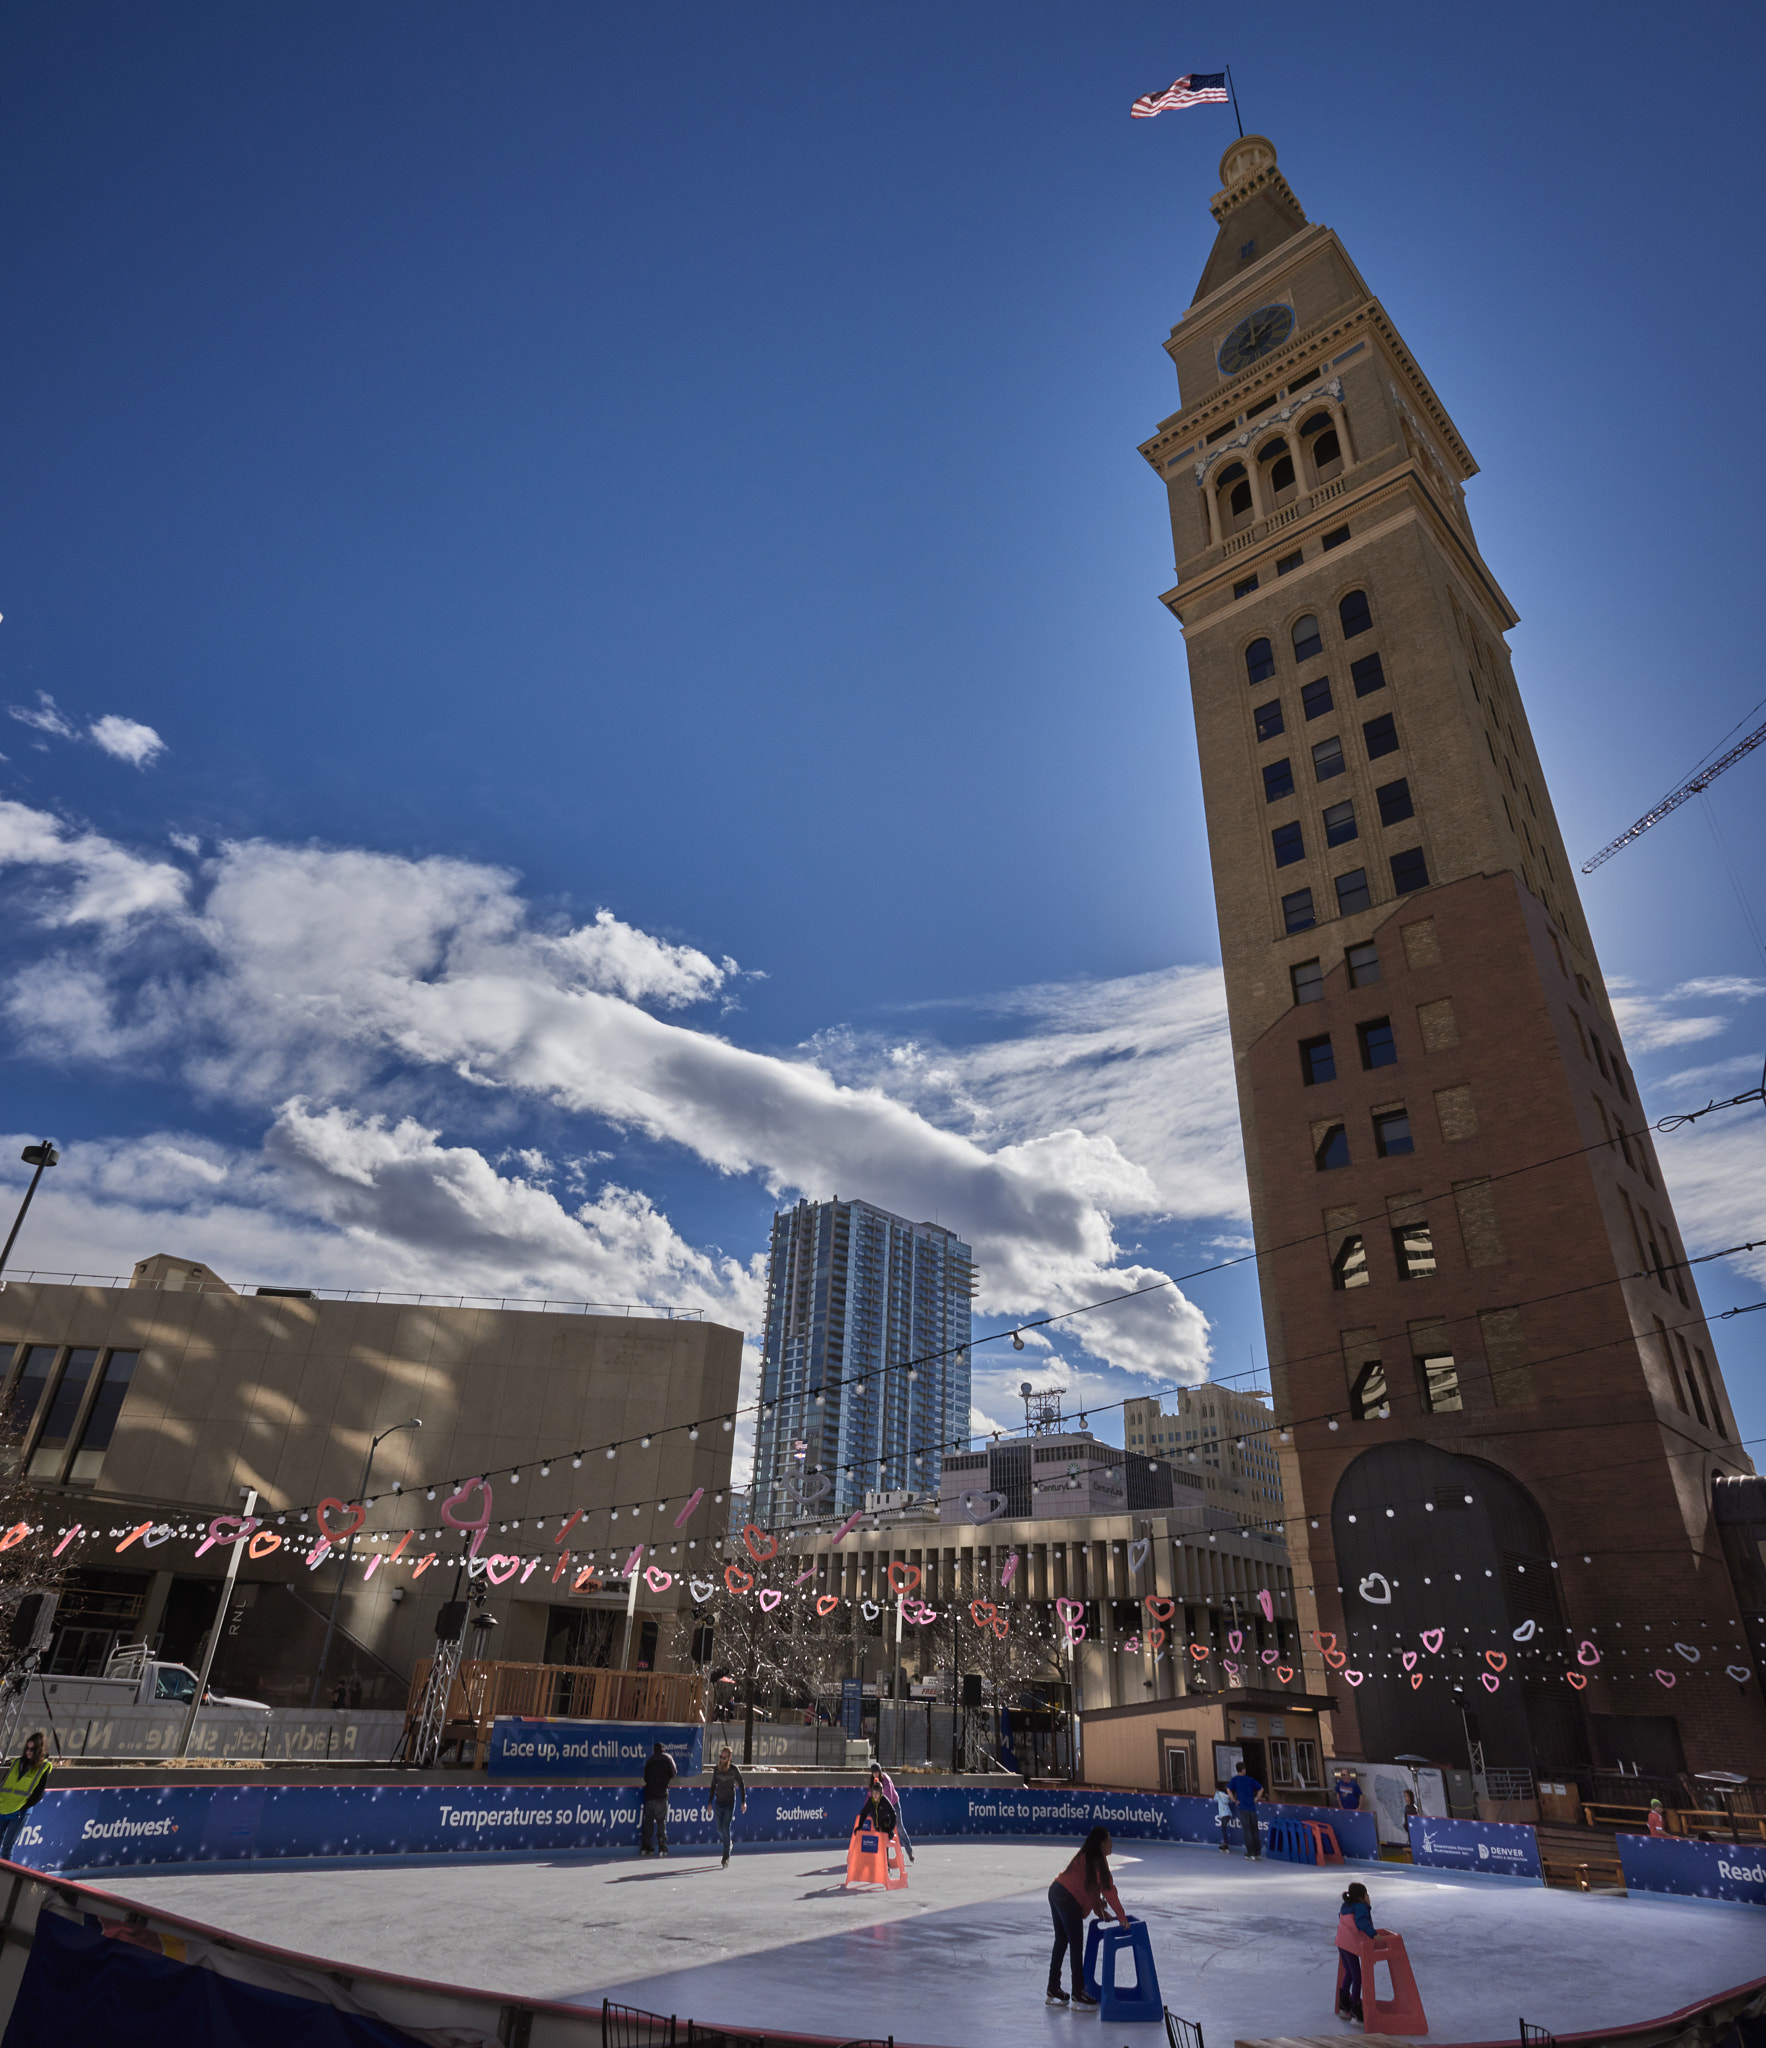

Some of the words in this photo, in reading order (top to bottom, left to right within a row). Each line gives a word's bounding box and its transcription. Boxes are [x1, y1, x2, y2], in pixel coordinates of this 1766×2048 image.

[1093, 1481, 1123, 1497] CenturyLink
[228, 1599, 247, 1635] RNL
[502, 1738, 535, 1757] Lace
[537, 1742, 560, 1762] up,
[562, 1740, 588, 1757] and
[591, 1740, 618, 1757] chill
[621, 1743, 647, 1758] out.
[439, 1805, 553, 1832] Temperatures
[555, 1809, 573, 1825] so
[576, 1804, 606, 1828] low,
[610, 1809, 636, 1829] you
[667, 1804, 698, 1822] have
[701, 1805, 714, 1822] to
[776, 1806, 824, 1821] Southwest
[968, 1801, 997, 1817] From
[998, 1801, 1015, 1817] ice
[1017, 1803, 1030, 1817] to
[1032, 1803, 1090, 1822] paradise?
[1092, 1804, 1168, 1827] Absolutely.
[82, 1816, 170, 1840] Southwest
[1490, 1846, 1524, 1857] DENVER
